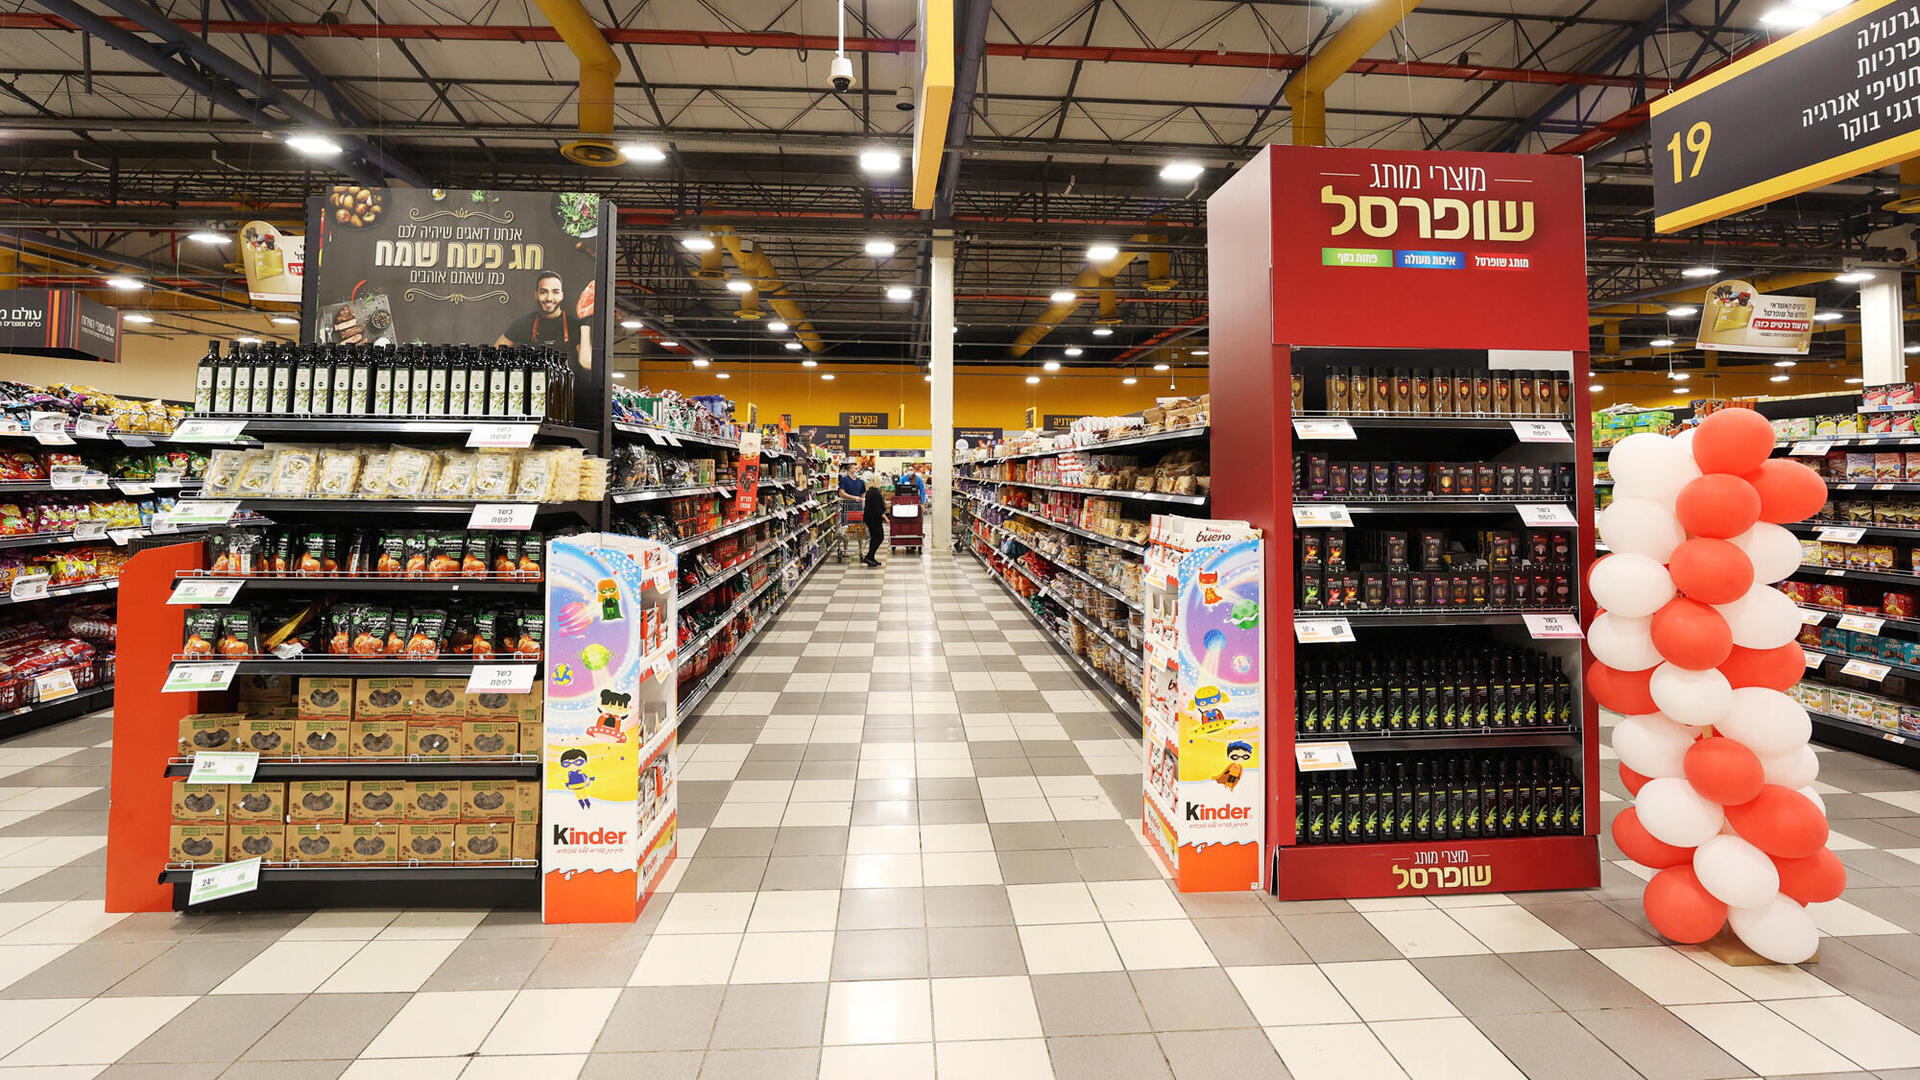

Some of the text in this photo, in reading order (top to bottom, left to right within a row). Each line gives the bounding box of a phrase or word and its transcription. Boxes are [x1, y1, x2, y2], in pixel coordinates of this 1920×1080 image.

[1857, 6, 1920, 50] גרנולה
[1857, 38, 1920, 79] פרכיות
[1802, 89, 1860, 128] אנרגיה
[1838, 109, 1881, 142] בוקר
[1666, 121, 1712, 184] 19
[1369, 163, 1487, 192] מוצרי מותג
[1320, 184, 1535, 242] שופרסל
[397, 223, 523, 241] אנחנו דואגים שיהיה לכם
[374, 239, 544, 271] חג פסח שמח
[1337, 252, 1378, 265] פחות כסף
[1404, 254, 1456, 266] איכות מעולה
[1474, 255, 1530, 268] מותג שופרסל
[410, 269, 505, 286] כמו שאתם אוהבים
[11, 306, 43, 321] עולם
[849, 415, 879, 425] הקצביה
[497, 508, 513, 516] כשר
[1196, 531, 1231, 543] bueno
[490, 678, 512, 686] לפסח
[1186, 801, 1251, 821] Kinder
[553, 824, 627, 845] Kinder
[1414, 849, 1469, 865] מוצרי מותג
[1391, 864, 1492, 890] שופרסל
